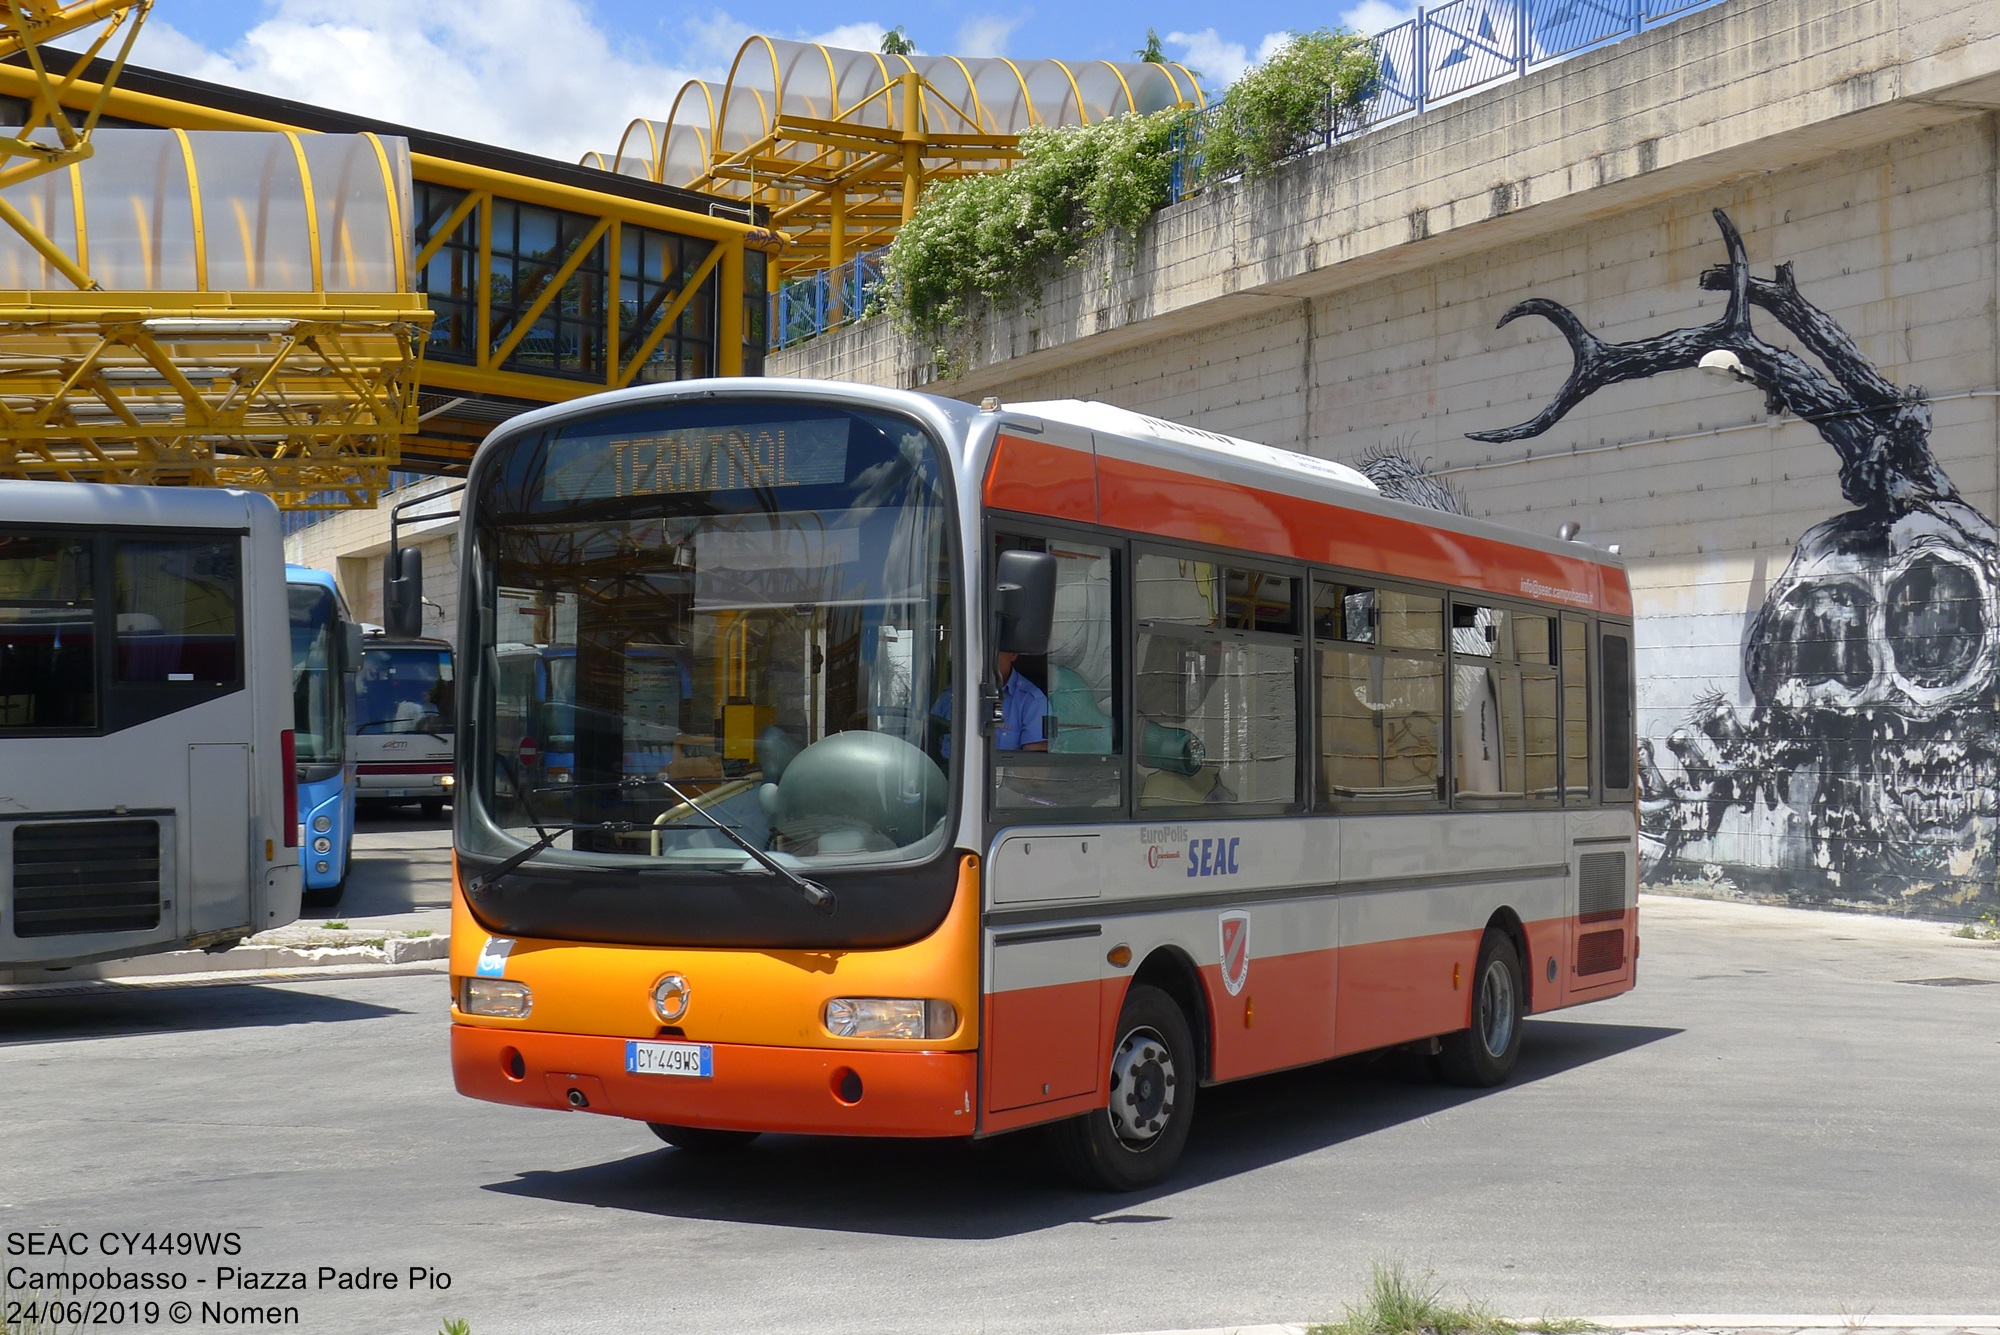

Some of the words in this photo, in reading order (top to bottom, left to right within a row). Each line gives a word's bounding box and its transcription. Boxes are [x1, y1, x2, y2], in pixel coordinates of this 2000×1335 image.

[609, 430, 800, 498] TERMINAL
[1141, 826, 1187, 843] EuroPolis
[1187, 837, 1240, 878] SEAC
